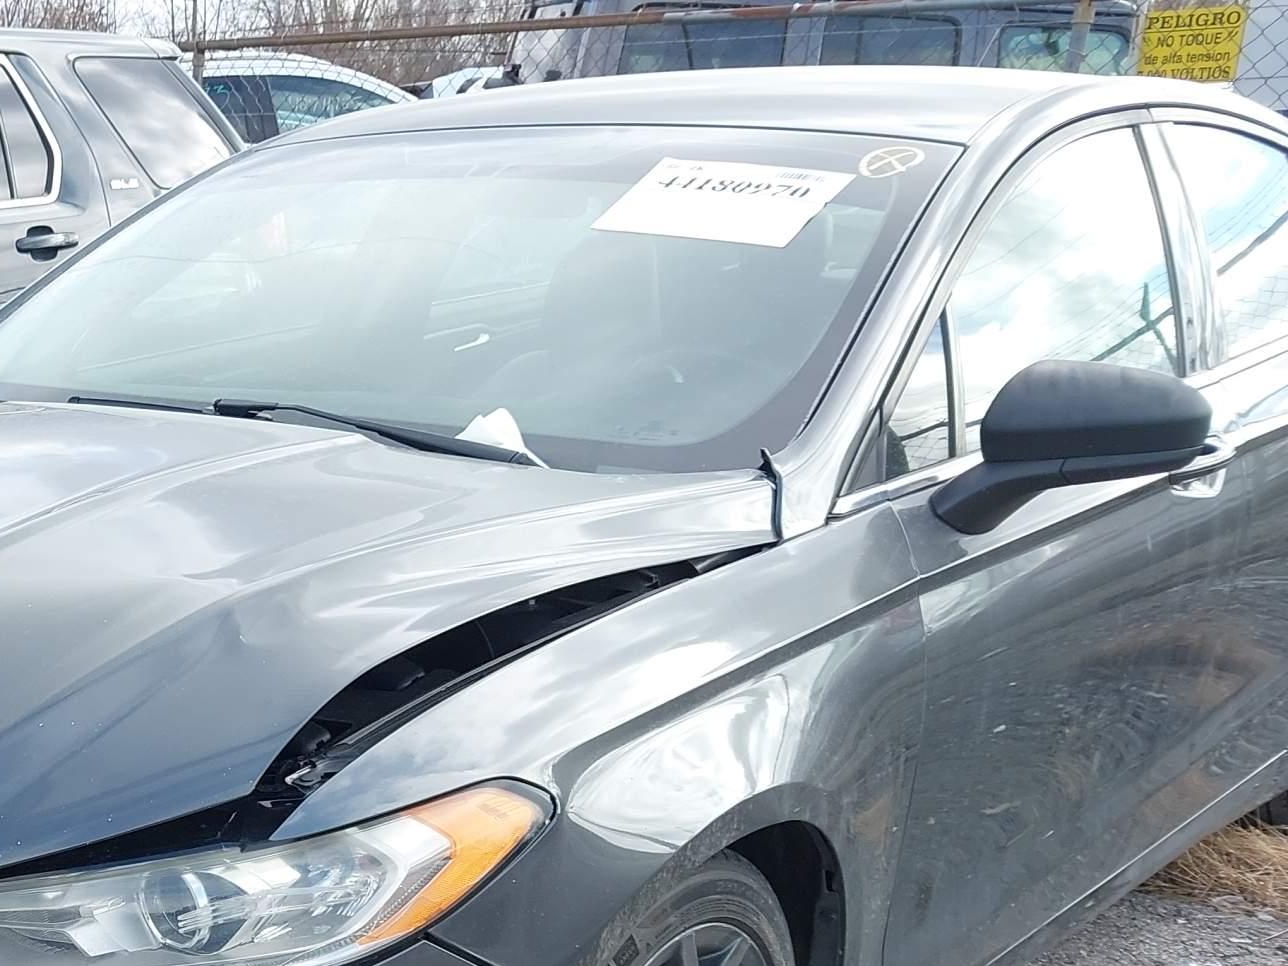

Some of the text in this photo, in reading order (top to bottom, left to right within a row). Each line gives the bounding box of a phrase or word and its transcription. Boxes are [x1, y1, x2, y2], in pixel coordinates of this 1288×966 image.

[1146, 11, 1241, 29] PELIGRO
[1155, 32, 1223, 48] NO TOQUE
[1144, 54, 1159, 65] de
[1186, 51, 1230, 63] tension
[1170, 65, 1231, 80] VOLTIOS
